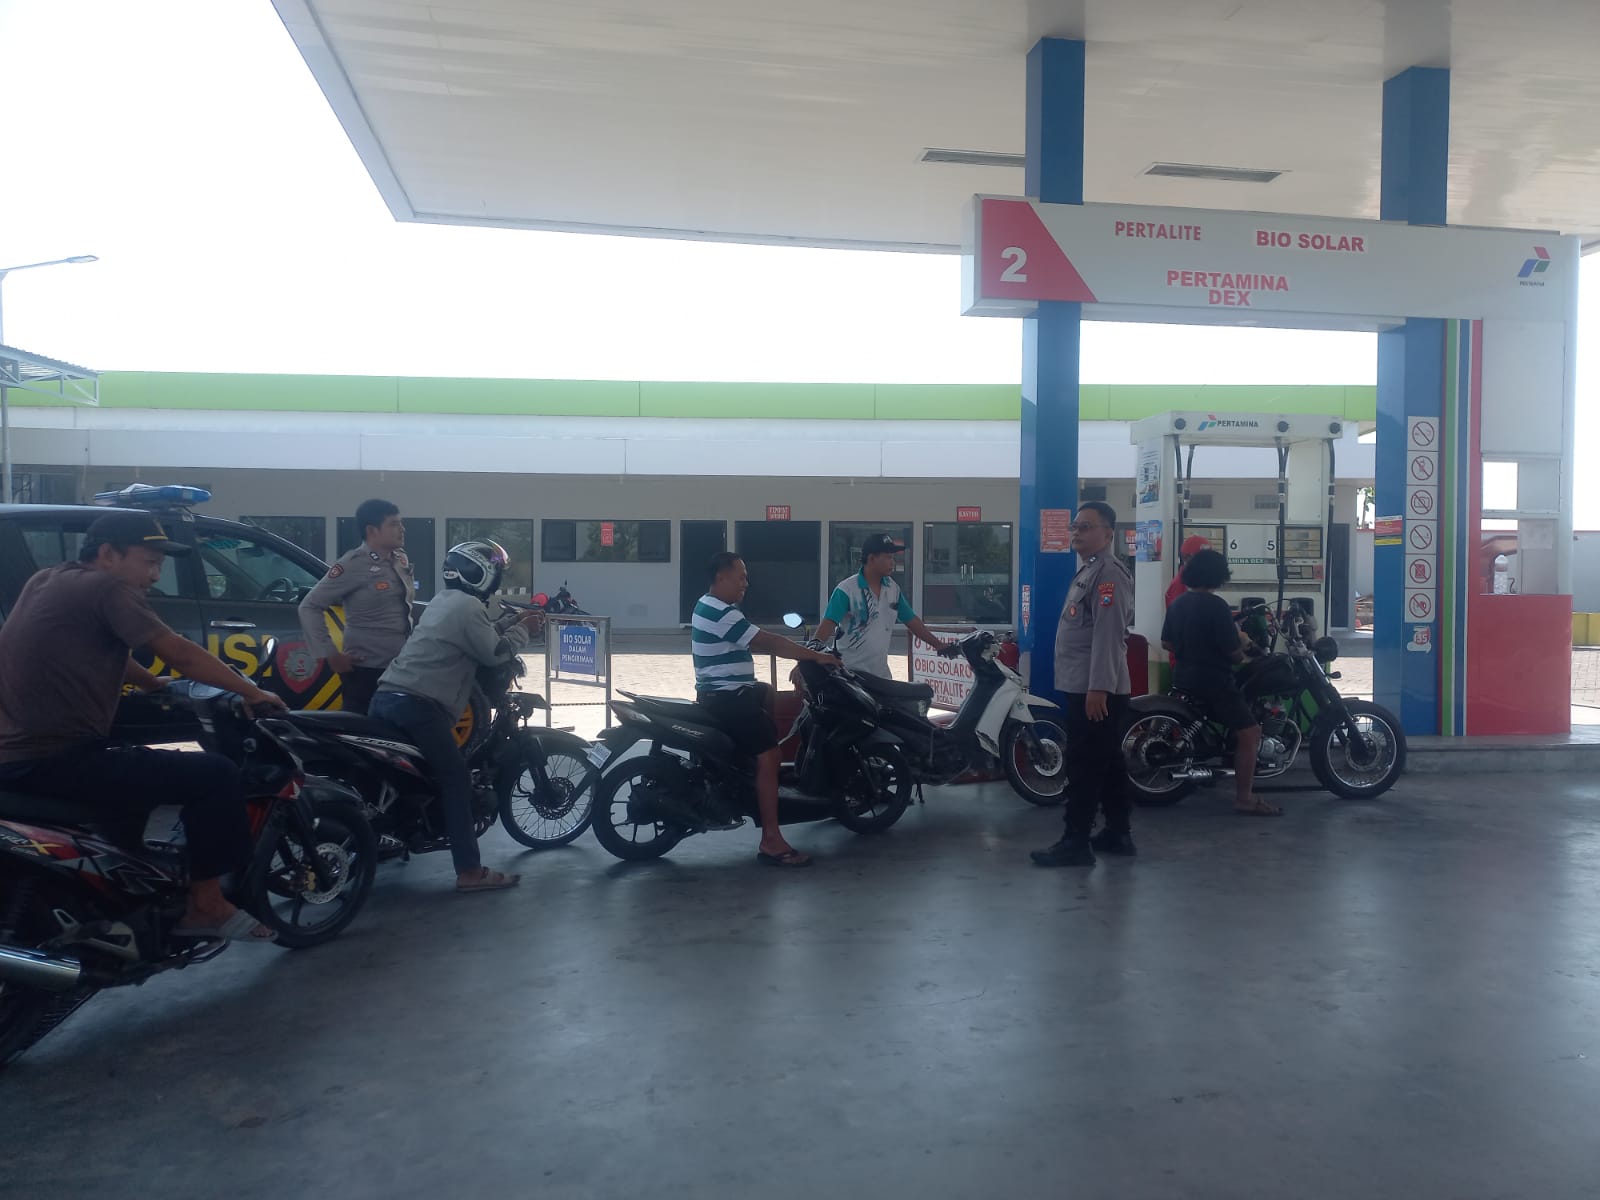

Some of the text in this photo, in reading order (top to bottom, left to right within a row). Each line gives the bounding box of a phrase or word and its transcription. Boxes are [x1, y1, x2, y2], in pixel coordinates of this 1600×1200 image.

[1115, 221, 1202, 241] PERTALITE
[1256, 230, 1364, 252] BIO SOLAR
[1000, 246, 1028, 283] 2
[1167, 270, 1289, 291] PERTAMINA
[1208, 290, 1251, 307] DEX
[1217, 419, 1259, 428] PERTAMINA
[1230, 539, 1238, 550] 6
[1266, 540, 1275, 551] 5
[563, 634, 592, 645] BIO SOLAR
[569, 645, 587, 653] DALAM
[562, 654, 594, 663] PENGIRIMAN
[921, 659, 965, 677] BIO SOLAR
